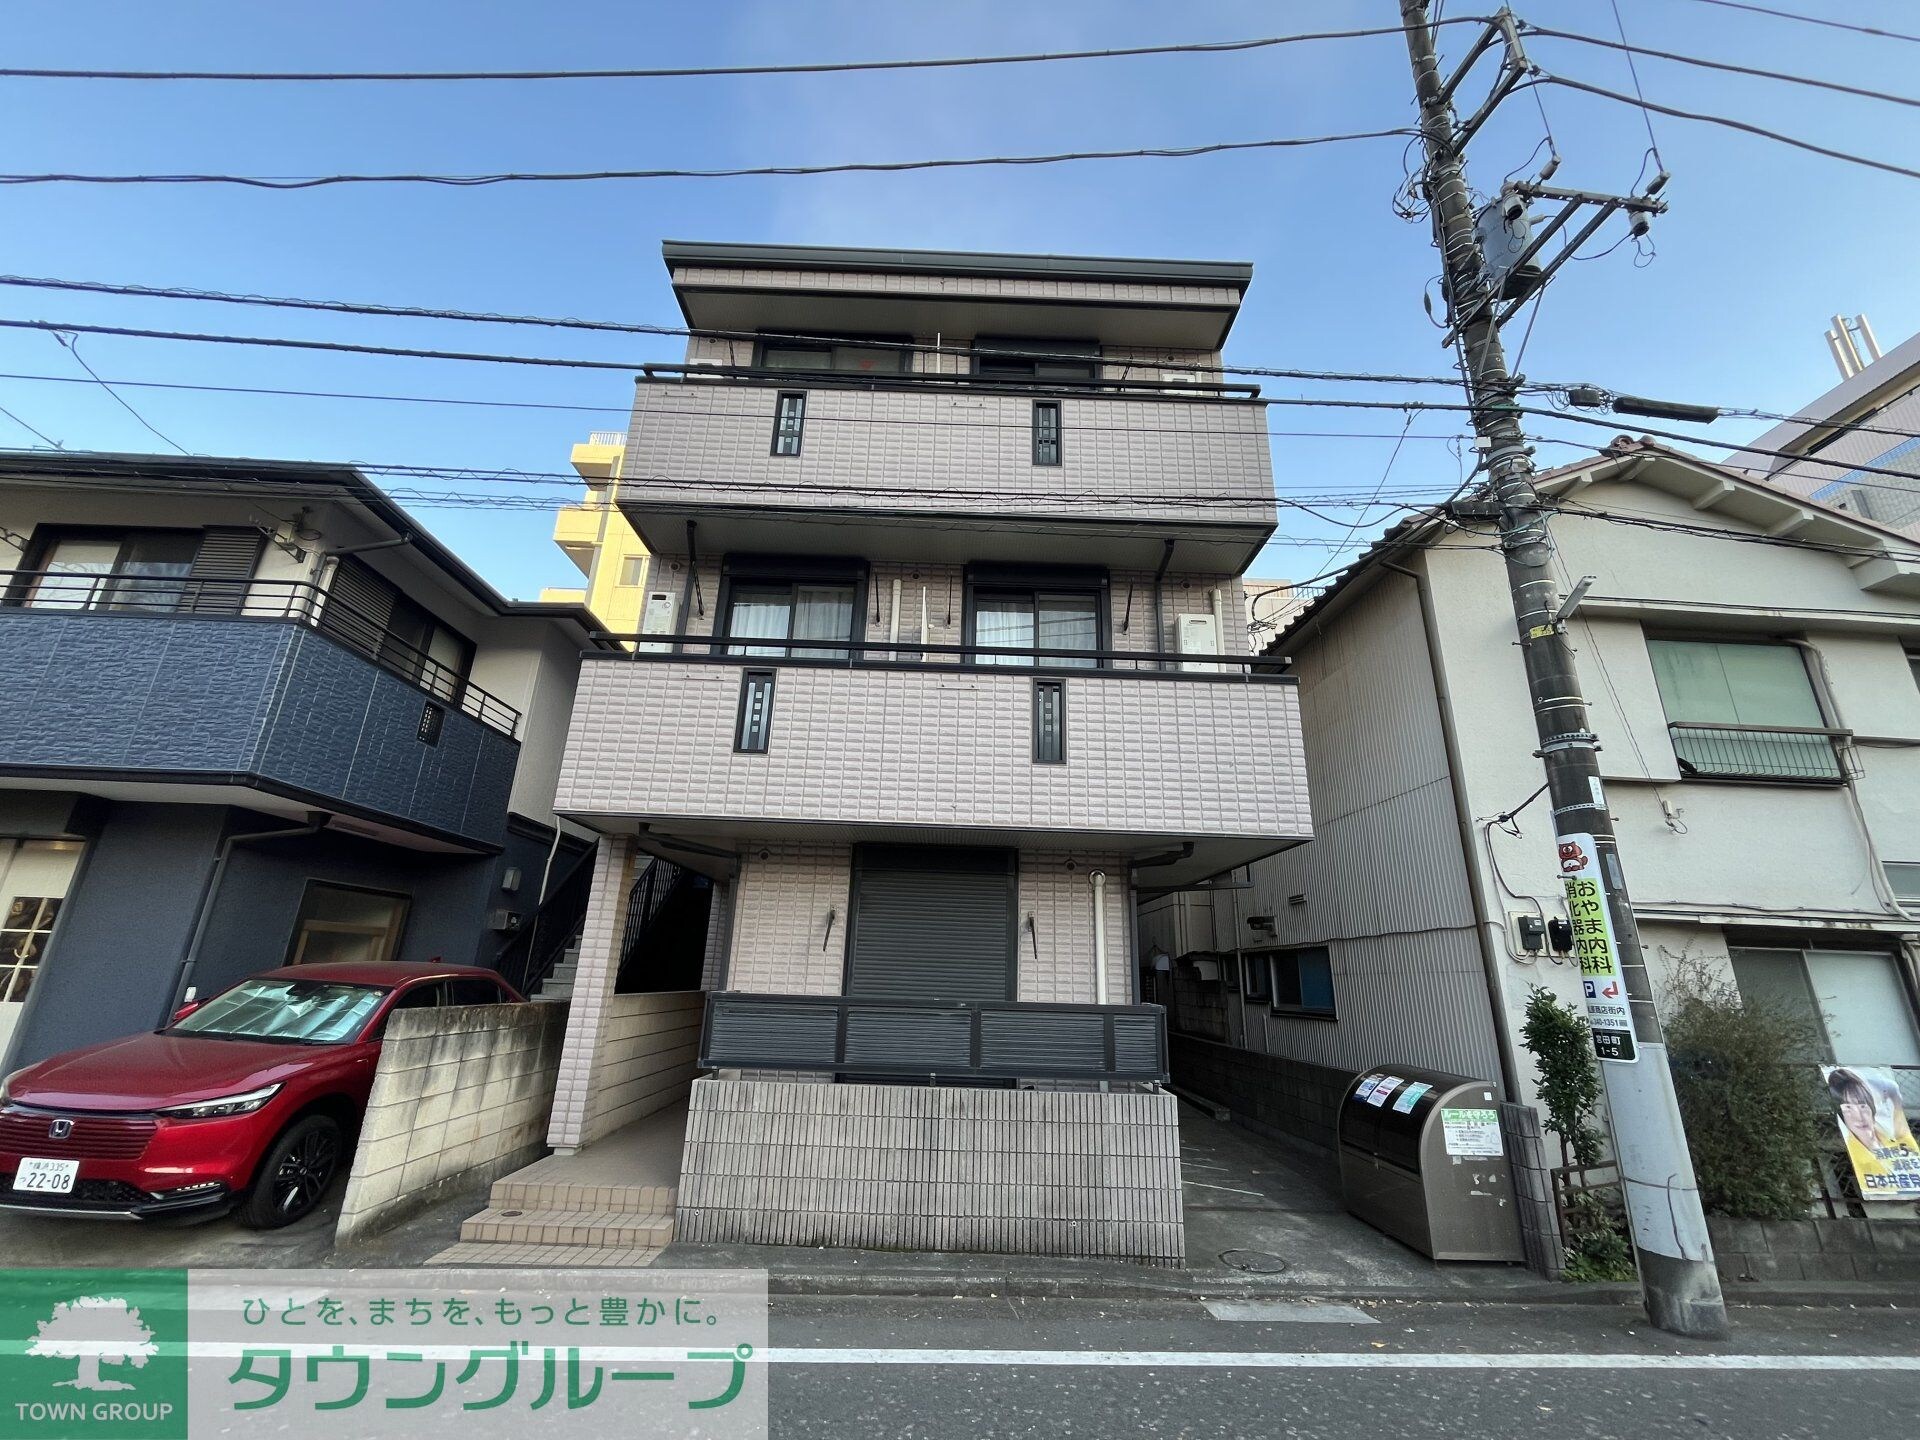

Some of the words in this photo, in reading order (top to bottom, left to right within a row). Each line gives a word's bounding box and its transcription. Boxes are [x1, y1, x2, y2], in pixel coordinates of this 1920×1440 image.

[1576, 881, 1613, 974] おやま内科
[1601, 1047, 1619, 1057] 1-5
[50, 1162, 65, 1172] 335
[26, 1172, 71, 1190] 22-08
